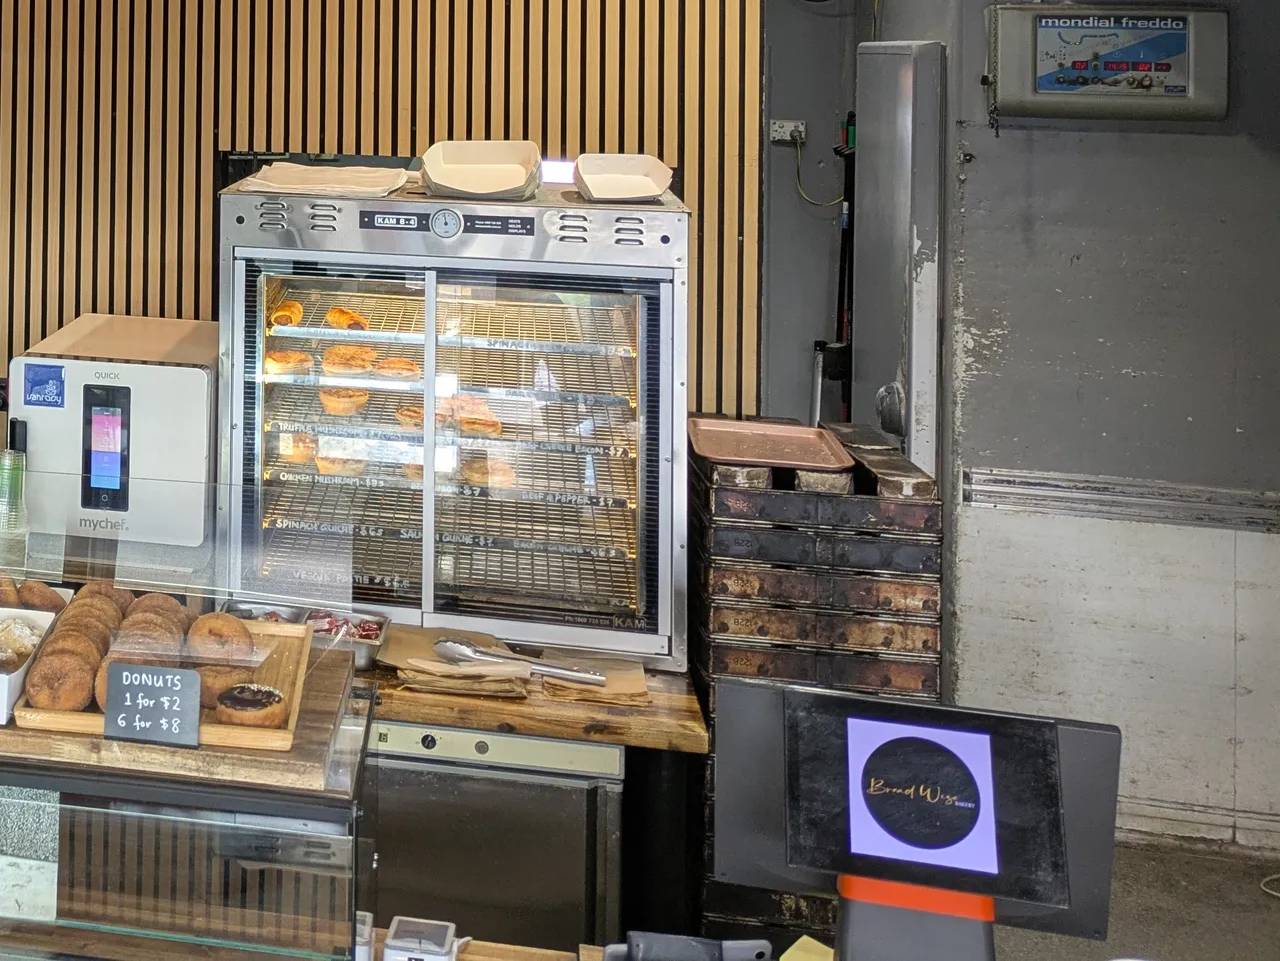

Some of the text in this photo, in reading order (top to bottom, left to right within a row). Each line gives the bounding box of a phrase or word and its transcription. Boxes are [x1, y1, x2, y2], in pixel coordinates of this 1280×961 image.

[1041, 16, 1184, 28] mondial freddo
[377, 217, 396, 225] KAM
[94, 372, 120, 380] QUICK
[276, 519, 318, 531] SPINACH
[615, 618, 645, 628] KAM
[122, 671, 182, 691] DONUTS
[124, 692, 181, 711] 1 for $2
[118, 714, 181, 734] 6 for $8
[866, 778, 916, 799] Bread
